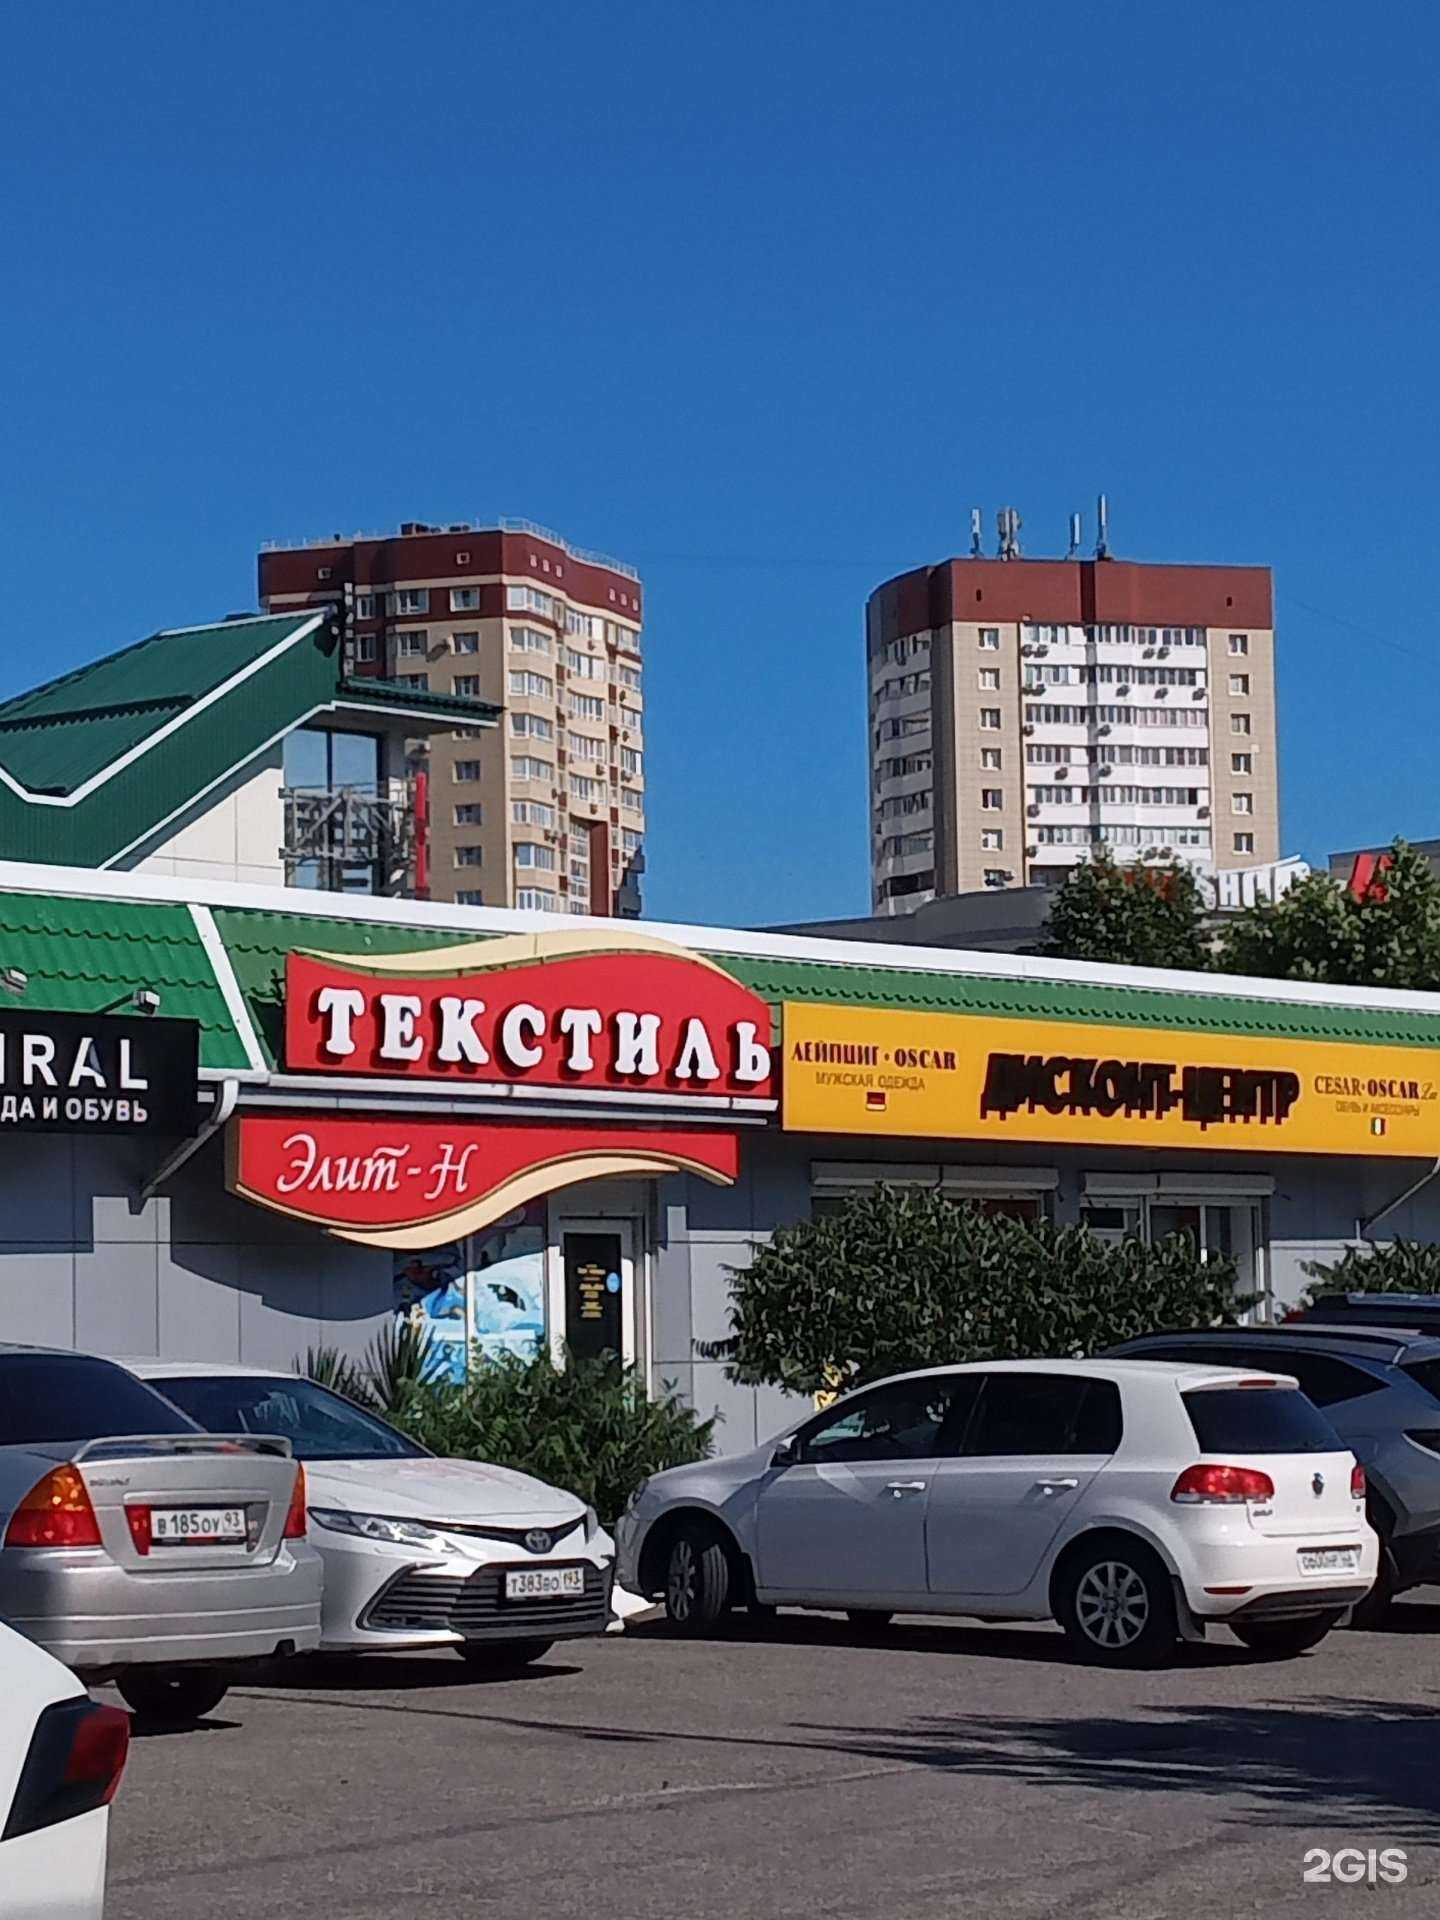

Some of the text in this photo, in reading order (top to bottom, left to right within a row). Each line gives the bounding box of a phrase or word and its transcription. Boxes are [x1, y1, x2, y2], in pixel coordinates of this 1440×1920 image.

[317, 986, 772, 1083] ТЕКСТИЛЬ
[894, 1048, 956, 1070] OSCAR
[43, 1097, 58, 1119] И
[65, 1098, 148, 1122] ОБУВЬ
